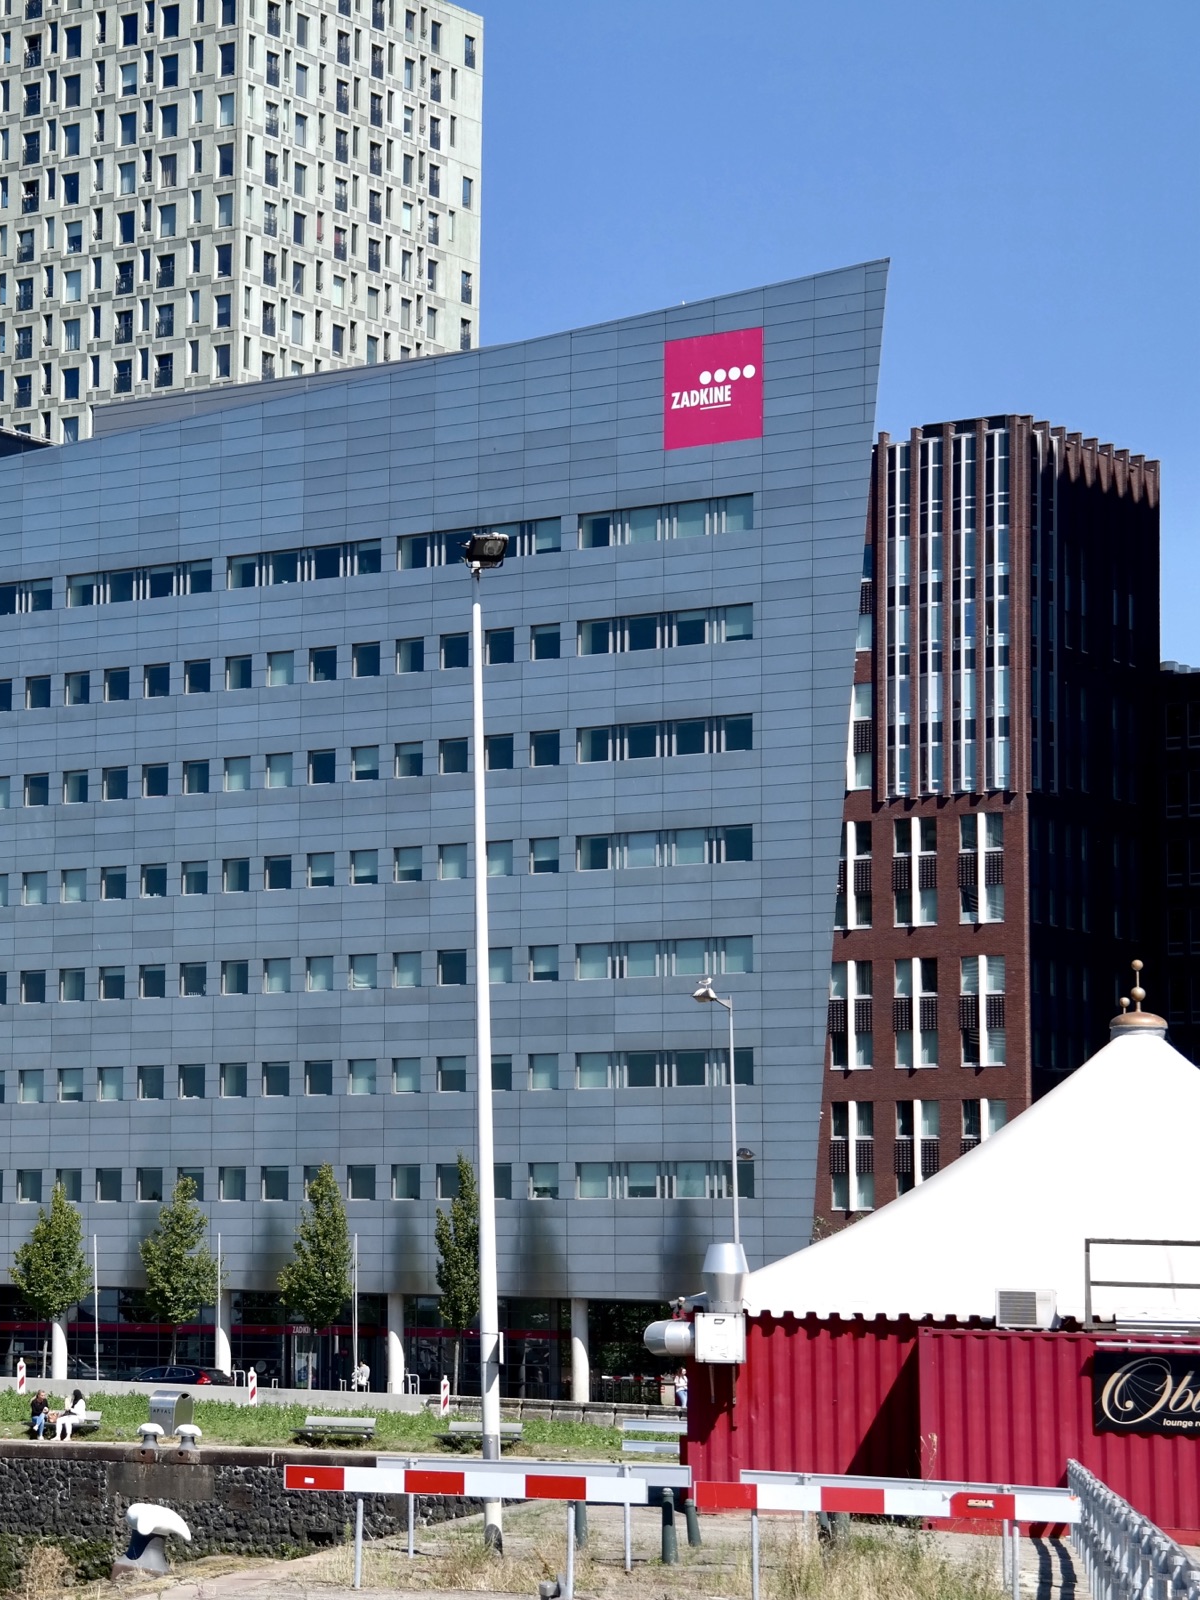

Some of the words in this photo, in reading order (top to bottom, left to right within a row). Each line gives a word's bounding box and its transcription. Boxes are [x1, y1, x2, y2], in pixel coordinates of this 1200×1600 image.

[671, 385, 731, 409] ZADKINE
[292, 1325, 318, 1334] ZADKIE
[1163, 1418, 1193, 1428] lounge
